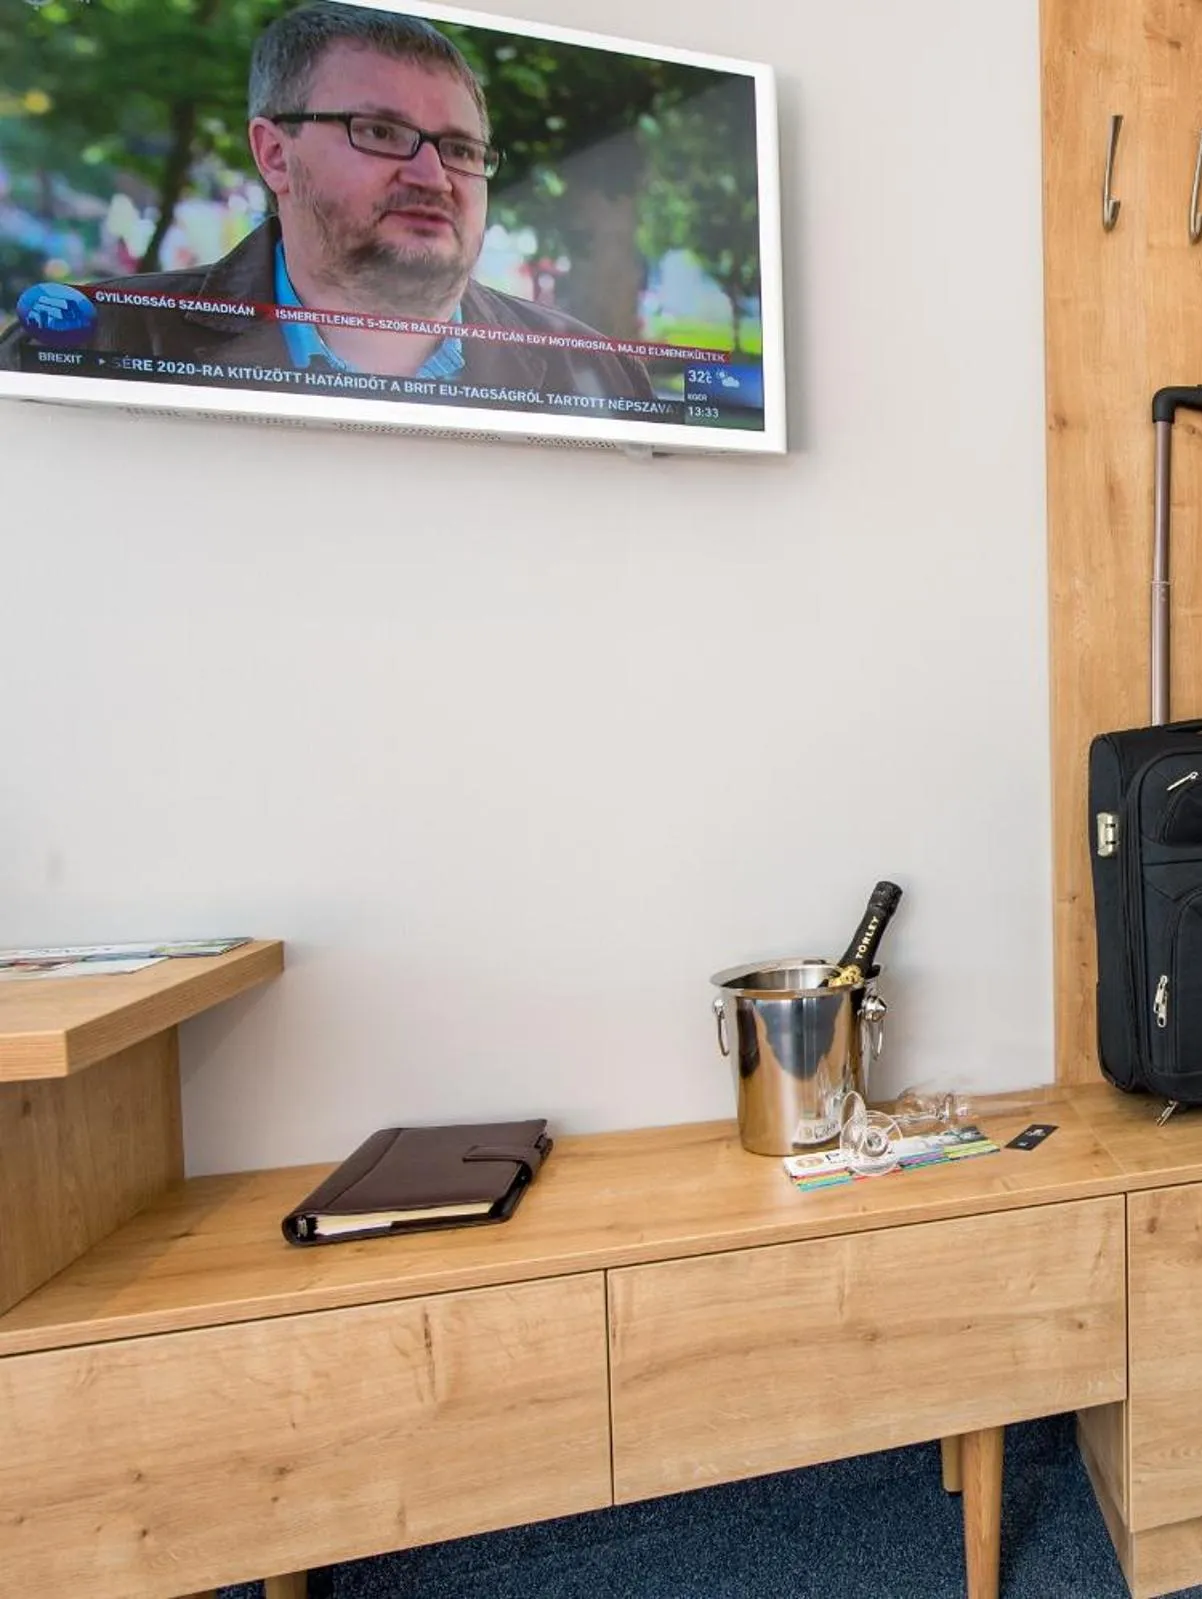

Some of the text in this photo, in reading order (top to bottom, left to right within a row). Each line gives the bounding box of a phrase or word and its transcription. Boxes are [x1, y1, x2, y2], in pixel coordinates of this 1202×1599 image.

[95, 290, 255, 317] GYILKOSSÁG SZABADKÁN
[275, 308, 364, 327] ISMERETLENEK
[471, 327, 486, 339] AZ
[488, 329, 524, 343] UTCÁN
[37, 351, 82, 365] BREXIT
[157, 360, 224, 378] 2020-RA
[390, 381, 400, 393] A
[404, 380, 437, 395] BRIT
[439, 384, 544, 404] EU-TAGSÁGRÓL
[546, 393, 605, 409] TARTOTT
[608, 396, 679, 415] NÉPSZAVA
[688, 406, 719, 418] 13:33
